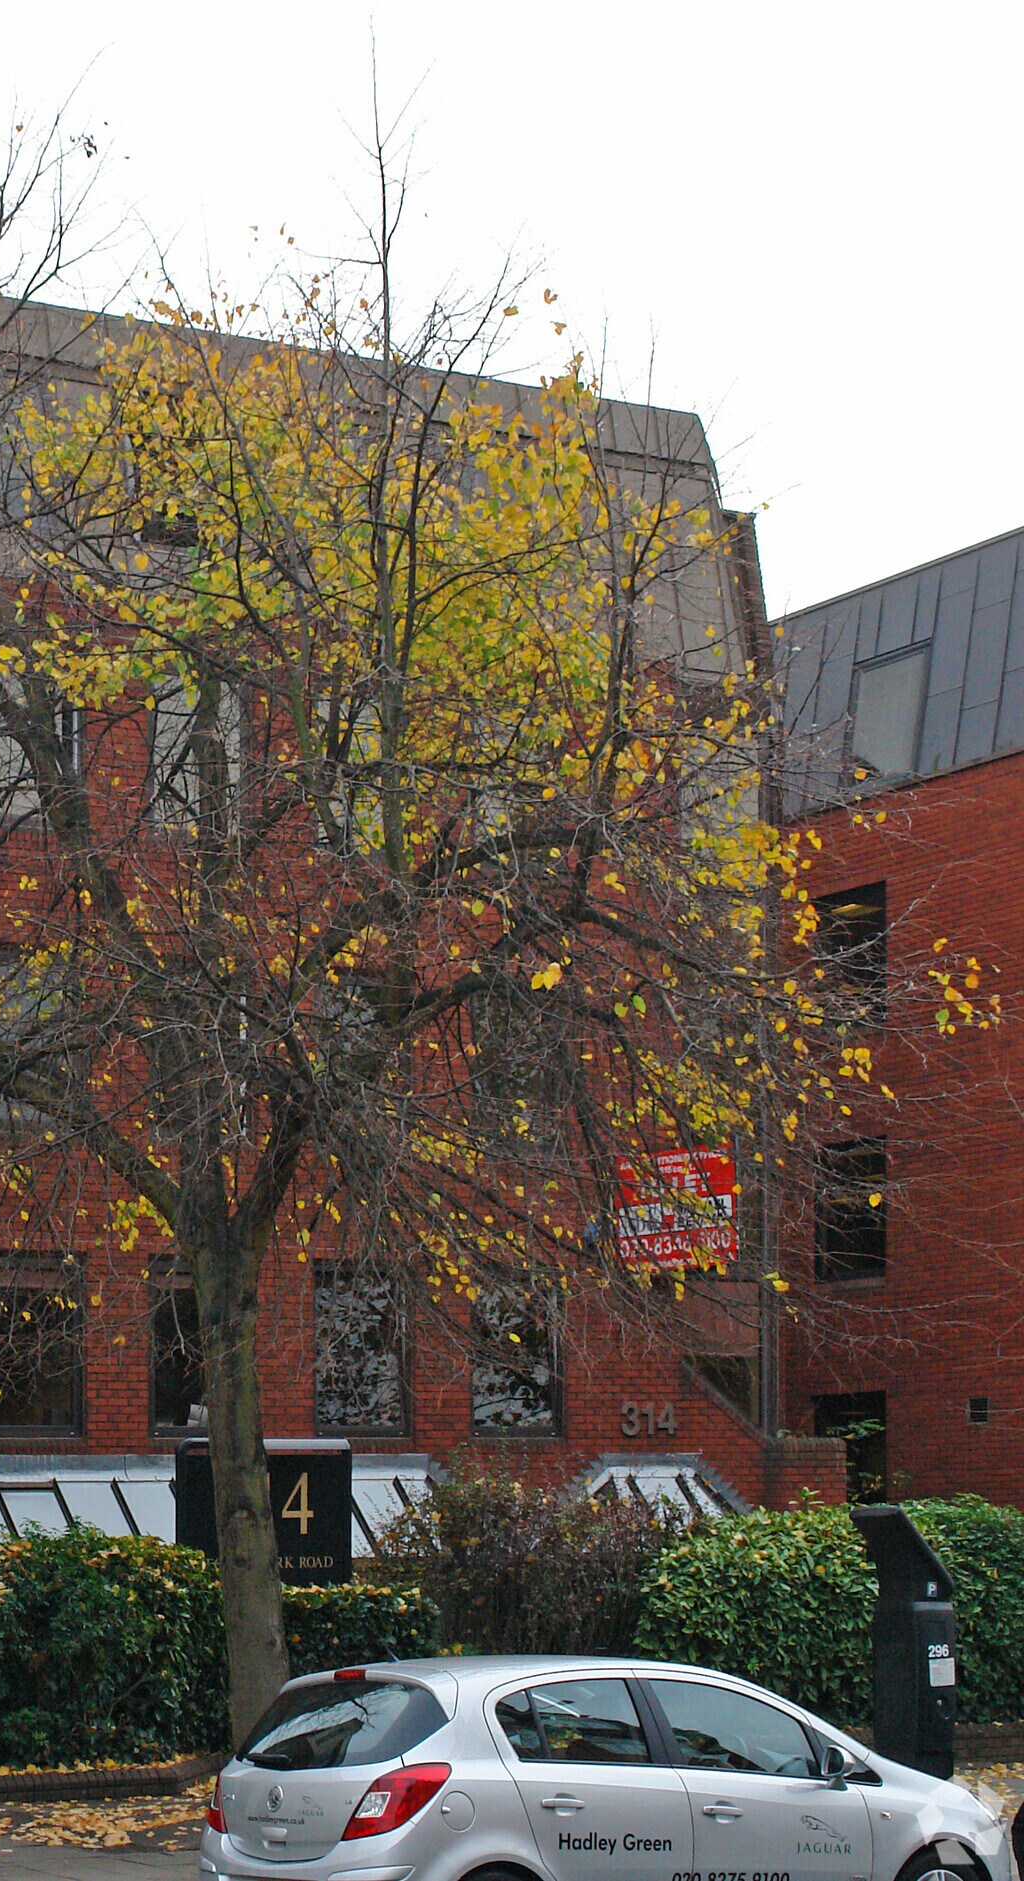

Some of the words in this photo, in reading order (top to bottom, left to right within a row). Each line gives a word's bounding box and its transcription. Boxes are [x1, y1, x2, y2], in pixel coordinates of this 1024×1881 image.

[621, 1401, 676, 1436] 314
[267, 1472, 315, 1536] 4
[278, 1556, 293, 1569] RK
[299, 1555, 334, 1569] ROAD
[927, 1644, 950, 1658] 296
[298, 1808, 324, 1817] JAGUAR
[558, 1832, 617, 1856] Hadley
[623, 1833, 673, 1851] Green
[796, 1842, 852, 1855] JAGUAR
